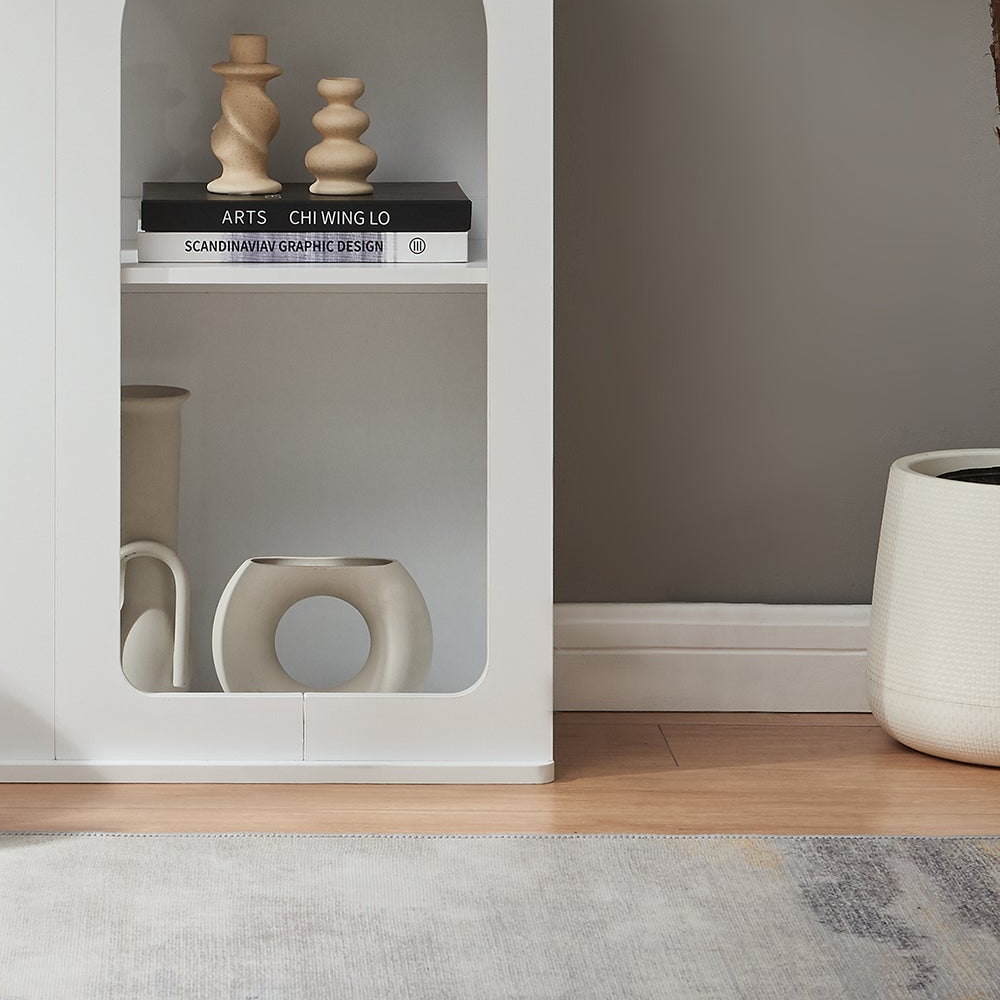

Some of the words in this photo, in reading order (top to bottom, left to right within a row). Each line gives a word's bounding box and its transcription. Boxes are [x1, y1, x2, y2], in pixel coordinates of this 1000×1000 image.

[221, 209, 267, 225] ARTS
[289, 210, 316, 225] CHI
[321, 210, 365, 225] WING
[369, 210, 390, 225] LO
[184, 240, 276, 252] SCANDINAVIAV
[278, 240, 334, 252] GRAPHIC
[337, 240, 383, 252] DESIGN
